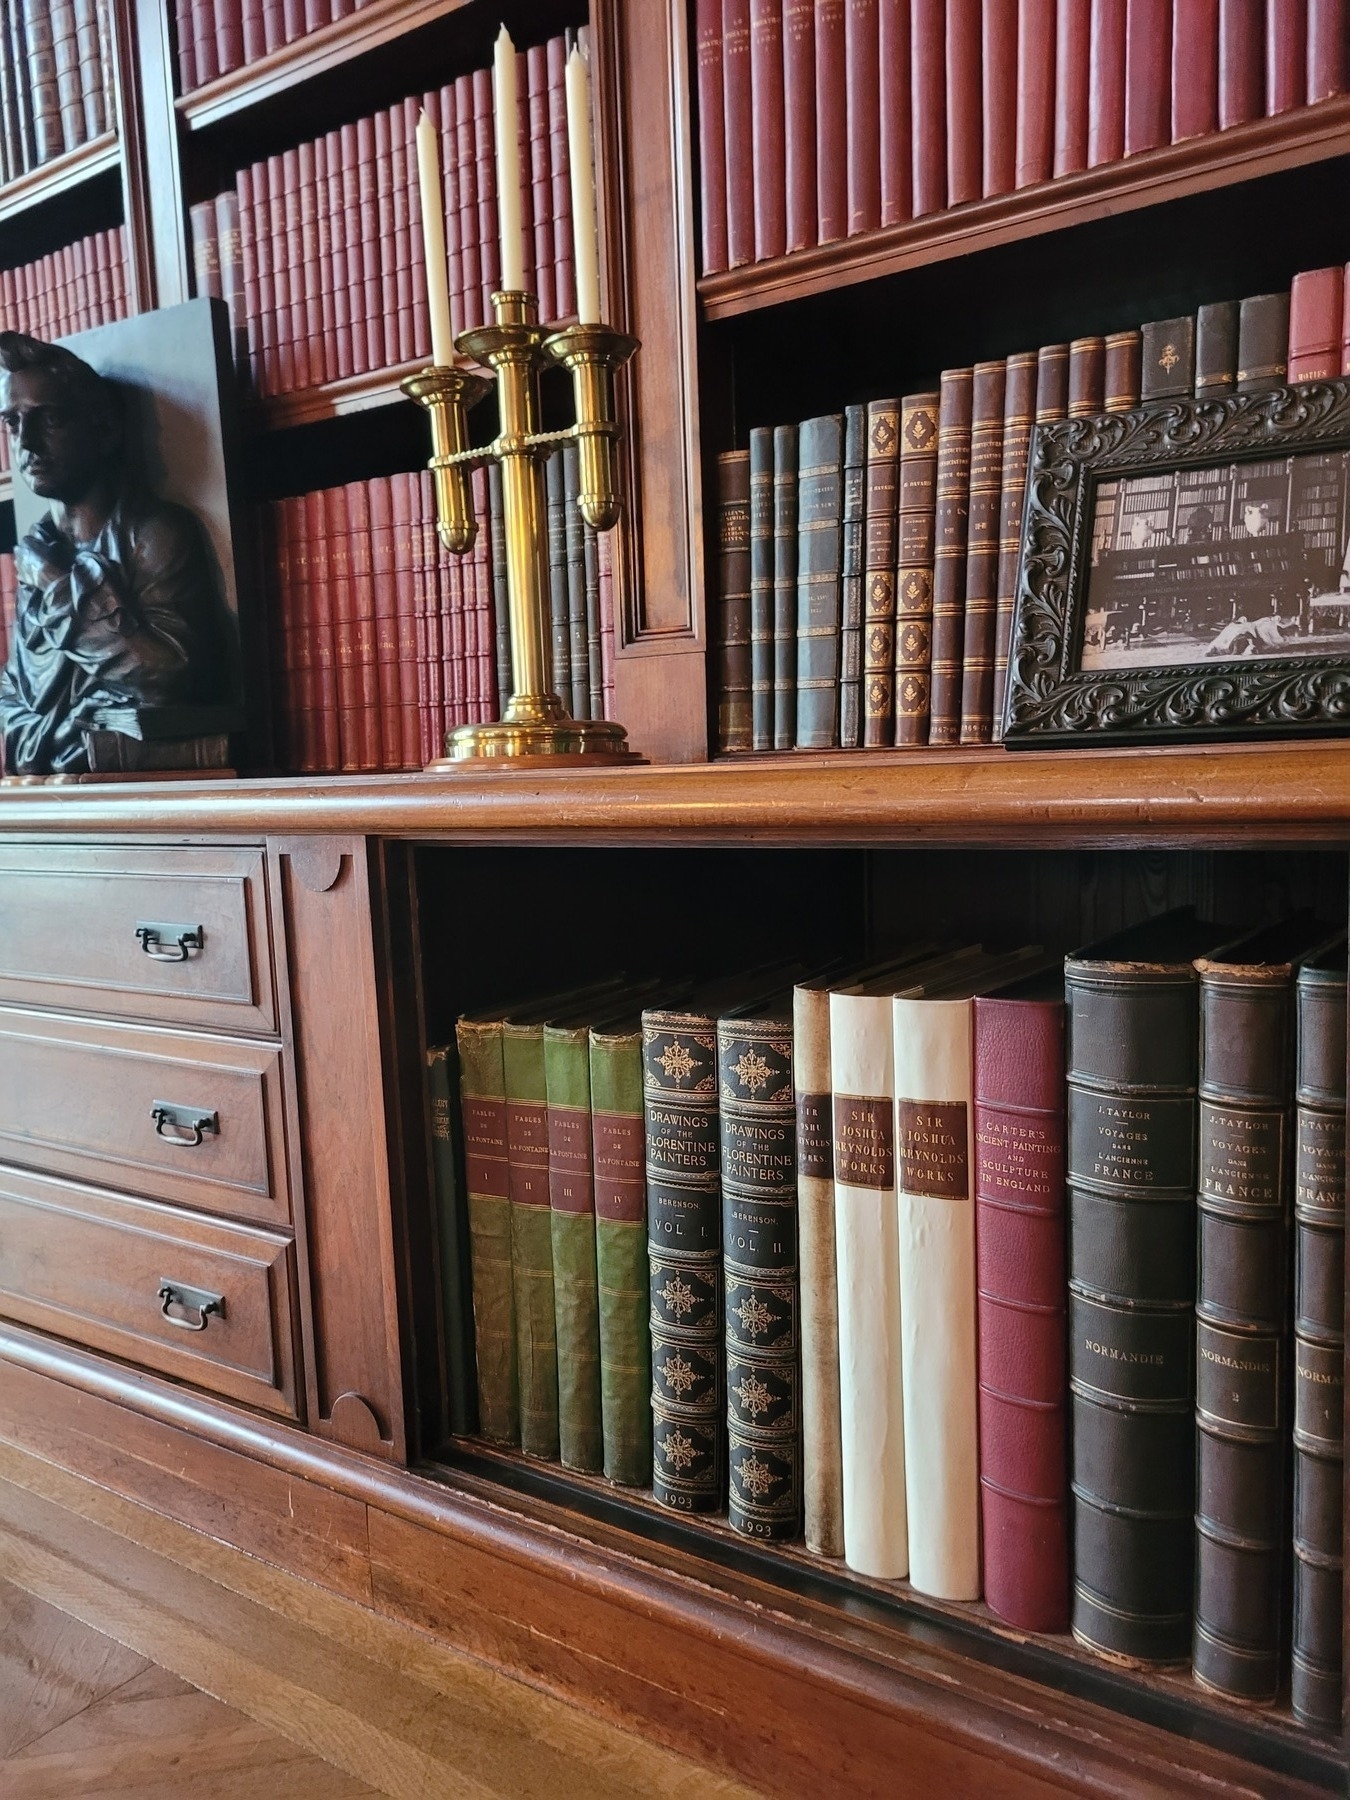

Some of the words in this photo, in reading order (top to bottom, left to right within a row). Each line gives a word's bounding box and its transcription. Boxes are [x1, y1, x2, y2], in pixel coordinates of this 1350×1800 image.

[472, 1109, 496, 1117] FABLES
[515, 1115, 542, 1123] FABLES
[650, 1110, 709, 1128] DRAWINGS
[852, 1111, 874, 1123] SIR
[1107, 1108, 1150, 1120] TAYLOR
[554, 1120, 580, 1129] FABLES
[916, 1116, 943, 1128] SIR
[1220, 1118, 1269, 1130] TAYLOR
[604, 1127, 631, 1136] FABLES
[677, 1130, 693, 1139] THE
[726, 1122, 785, 1140] DRAWINGS
[842, 1125, 885, 1140] JOSHUA
[908, 1130, 956, 1145] JOSHUA
[986, 1122, 1045, 1139] CARTER'S
[1098, 1127, 1148, 1141] VOYAGES
[476, 1137, 504, 1146] FONTAINE
[646, 1134, 716, 1153] FLORENTINE
[752, 1143, 769, 1151] THE
[975, 1133, 1009, 1148] ANCIENT
[1013, 1141, 1061, 1154] PAINTING
[1113, 1143, 1131, 1151] DANS
[1212, 1140, 1266, 1154] VOYAGES
[518, 1145, 549, 1153] FONTAINE
[558, 1150, 587, 1160] FONTAINE
[722, 1146, 792, 1166] FLORENTINE
[608, 1158, 640, 1167] FONTAINE
[1008, 1154, 1024, 1163] AND
[1099, 1152, 1148, 1165] L'ANCIENNE
[1228, 1159, 1247, 1167] DANS
[841, 1158, 886, 1174] WORKS
[982, 1160, 1048, 1179] SCULPTURE
[1094, 1164, 1153, 1180] FRANCE
[907, 1166, 954, 1182] WORKS
[526, 1182, 532, 1190] II
[982, 1174, 992, 1182] IN
[996, 1177, 1050, 1193] ENGLAND
[1205, 1178, 1272, 1198] FRANCE
[564, 1188, 572, 1197] III
[655, 1219, 687, 1236] VOL.
[729, 1234, 759, 1252] VOL.
[1084, 1339, 1164, 1365] NORMANDIE
[1201, 1348, 1270, 1372] NORMANDIE
[1298, 1366, 1344, 1385] NORMA
[665, 1492, 693, 1509] 1903
[741, 1518, 772, 1537] 1903
